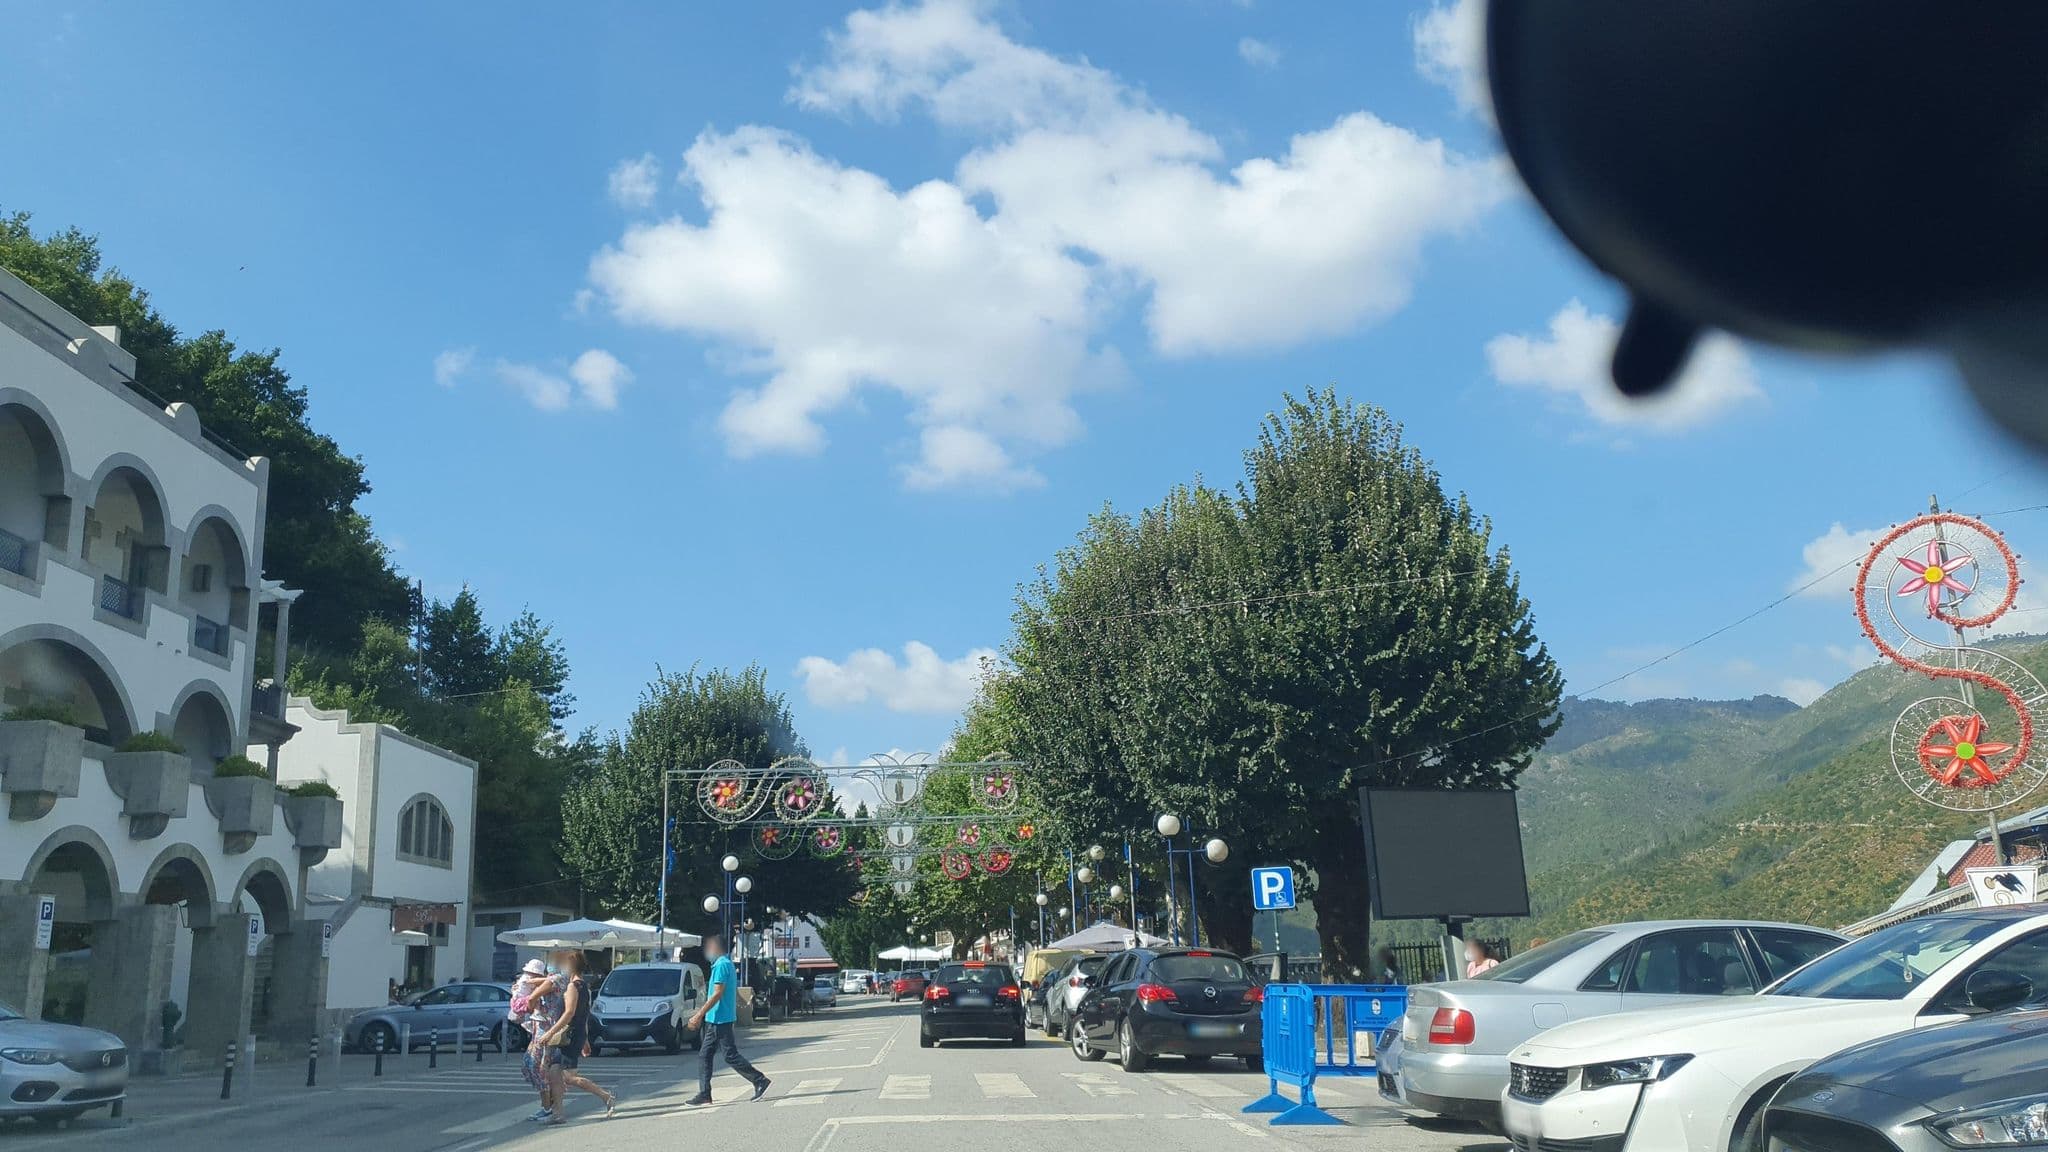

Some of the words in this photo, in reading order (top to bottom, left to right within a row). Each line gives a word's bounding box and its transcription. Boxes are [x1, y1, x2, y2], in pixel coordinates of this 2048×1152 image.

[1260, 871, 1284, 906] P
[43, 903, 51, 918] P
[251, 920, 258, 933] P
